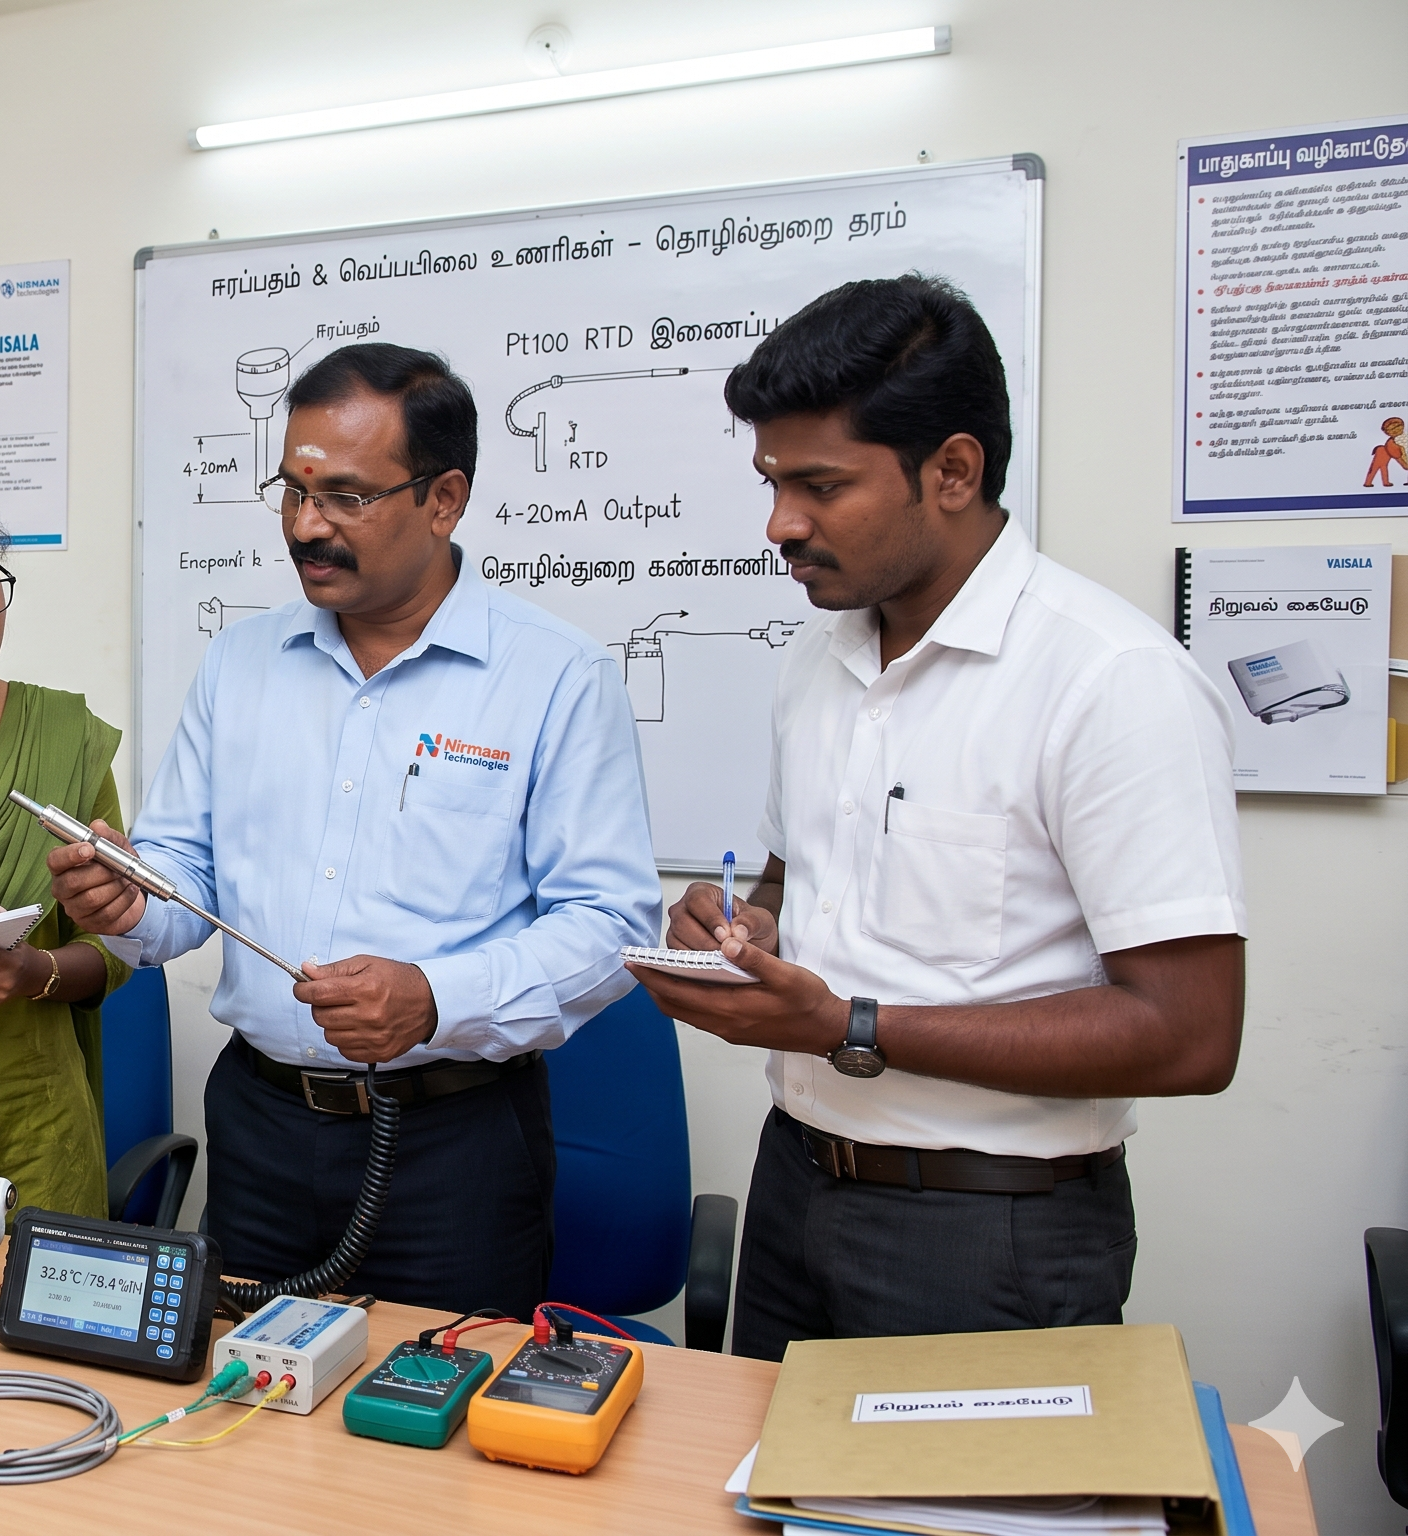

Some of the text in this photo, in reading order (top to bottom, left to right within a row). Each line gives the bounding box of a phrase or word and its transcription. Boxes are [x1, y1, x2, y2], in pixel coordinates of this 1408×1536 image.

[1198, 134, 1408, 178] பாதுகாப்பு வழிகாட்டுத
[212, 263, 301, 300] ஈரப்பதம்
[312, 263, 328, 287] &
[490, 229, 614, 268] உணரிகள்
[655, 216, 833, 258] தொழில்துறை
[848, 200, 907, 242] தரம்
[315, 315, 381, 341] ஈரப்பதம்
[506, 332, 569, 357] Pt100
[585, 325, 634, 351] RTD
[182, 457, 238, 477] 4-20mA
[569, 450, 608, 470] RTD
[495, 492, 682, 528] 4-20mA Output
[481, 553, 635, 588] தொழில்துறை
[1326, 557, 1373, 569] VAISALA
[1208, 596, 1369, 618] நிறுவல் கையேடு
[443, 751, 509, 771] Technologies
[444, 738, 511, 762] Nirmaan
[873, 1396, 1073, 1412] நிறுவல் கையேடு
